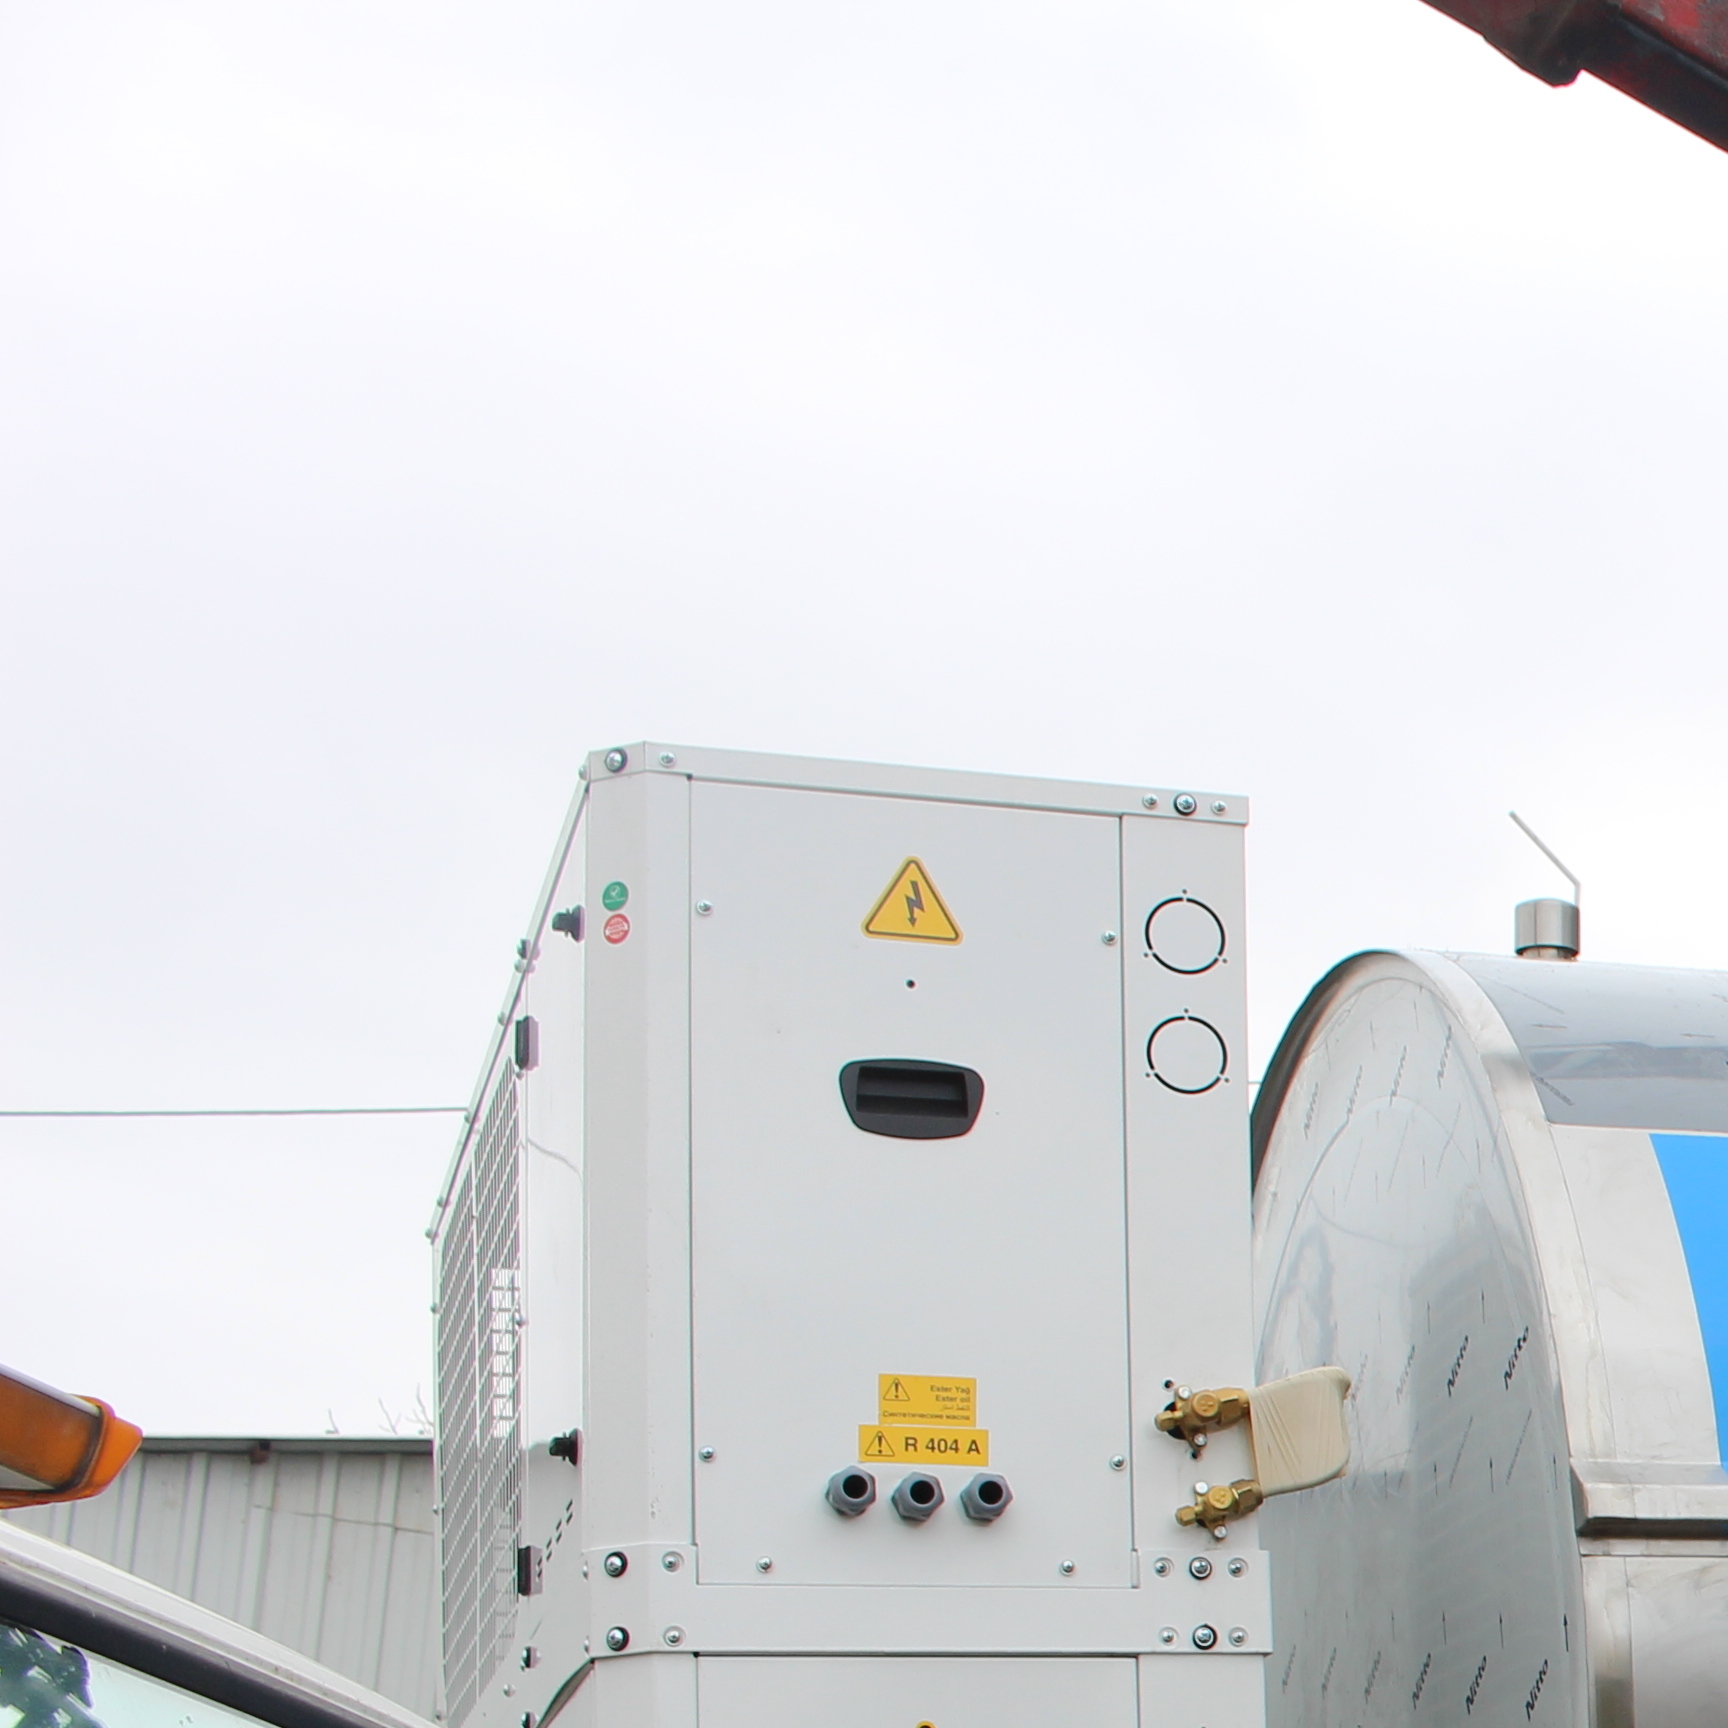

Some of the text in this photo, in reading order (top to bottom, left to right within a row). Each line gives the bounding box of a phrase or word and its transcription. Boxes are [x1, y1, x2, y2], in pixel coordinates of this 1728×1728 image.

[1447, 1334, 1469, 1398] Nitto
[1504, 1326, 1530, 1391] Nitto
[904, 1436, 982, 1455] R 404 A
[1411, 1652, 1432, 1711] Nitto
[1465, 1654, 1488, 1715] Nitto
[1525, 1658, 1549, 1722] Nitto
